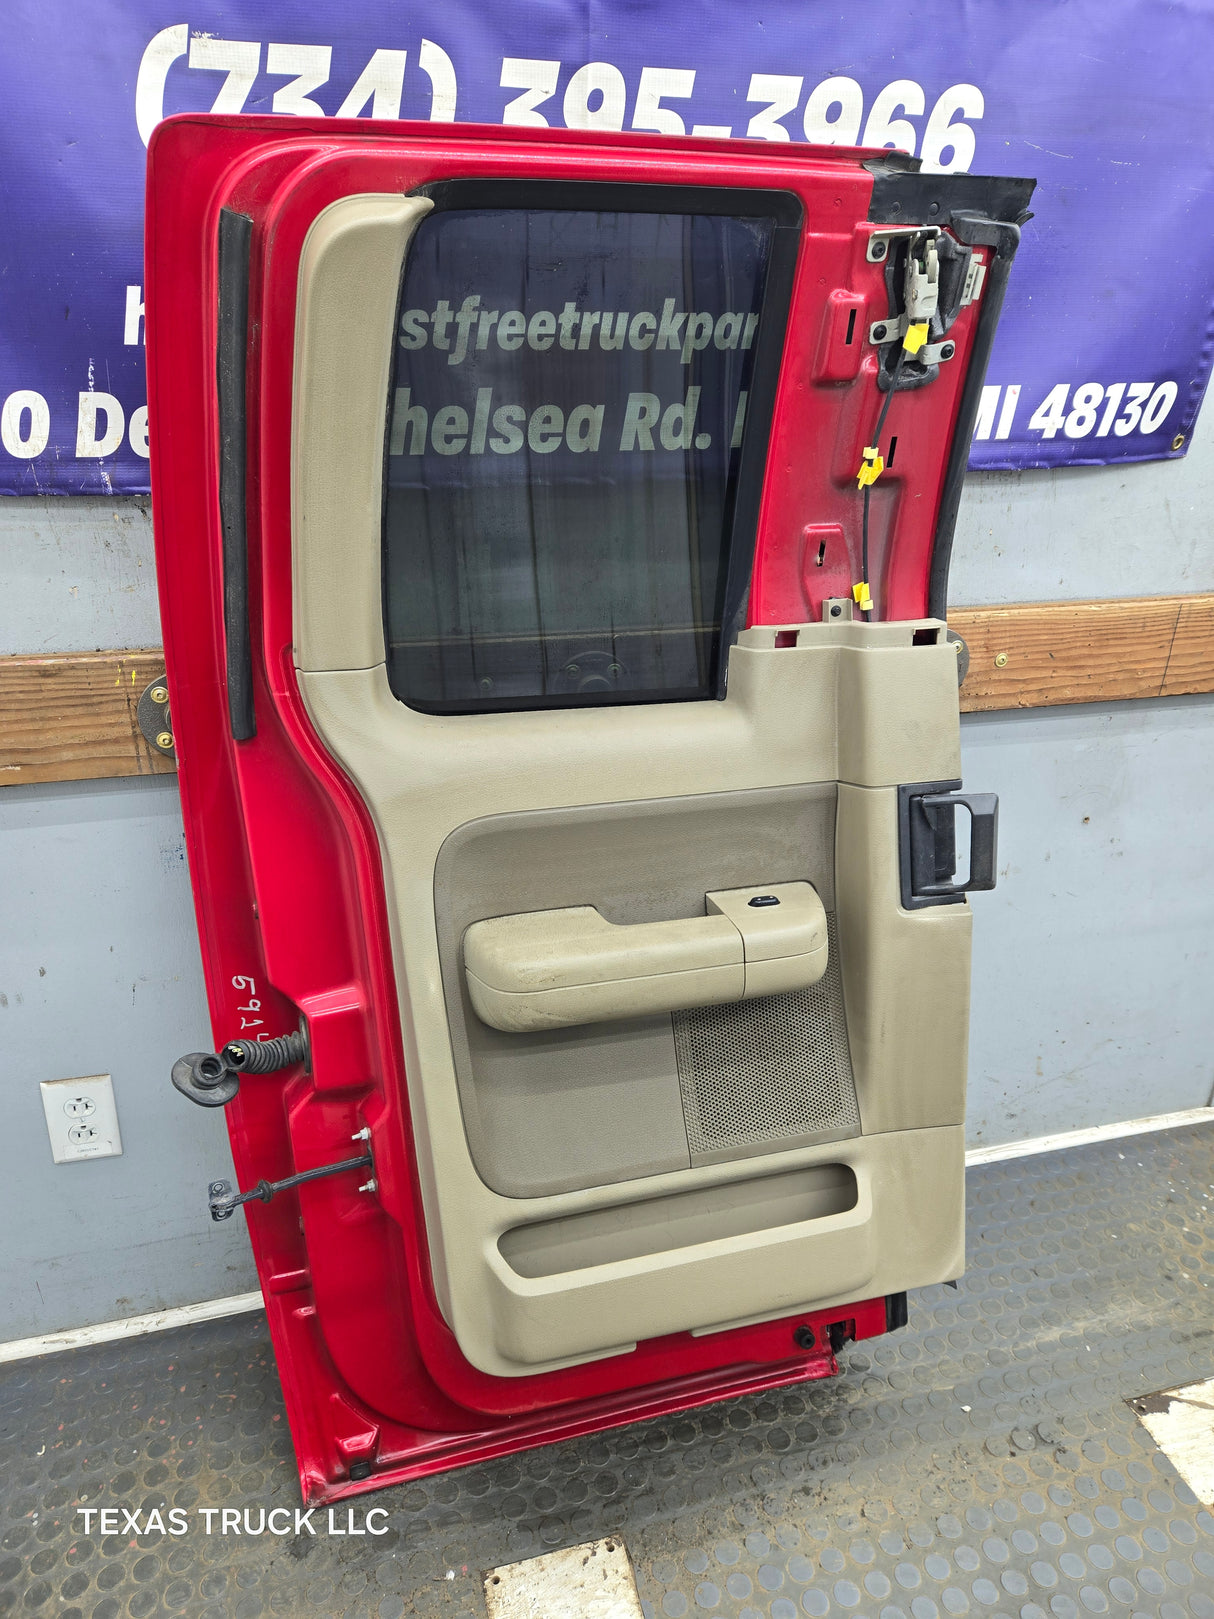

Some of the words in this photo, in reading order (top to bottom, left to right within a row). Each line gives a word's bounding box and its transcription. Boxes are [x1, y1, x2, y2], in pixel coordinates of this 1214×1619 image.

[136, 24, 457, 149] (734)
[500, 57, 985, 175] 395-3966
[400, 295, 760, 365] stfreetruckpar
[76, 391, 150, 459] De
[390, 387, 605, 456] helsea
[619, 386, 711, 451] Rd.
[1028, 381, 1178, 439] 48130
